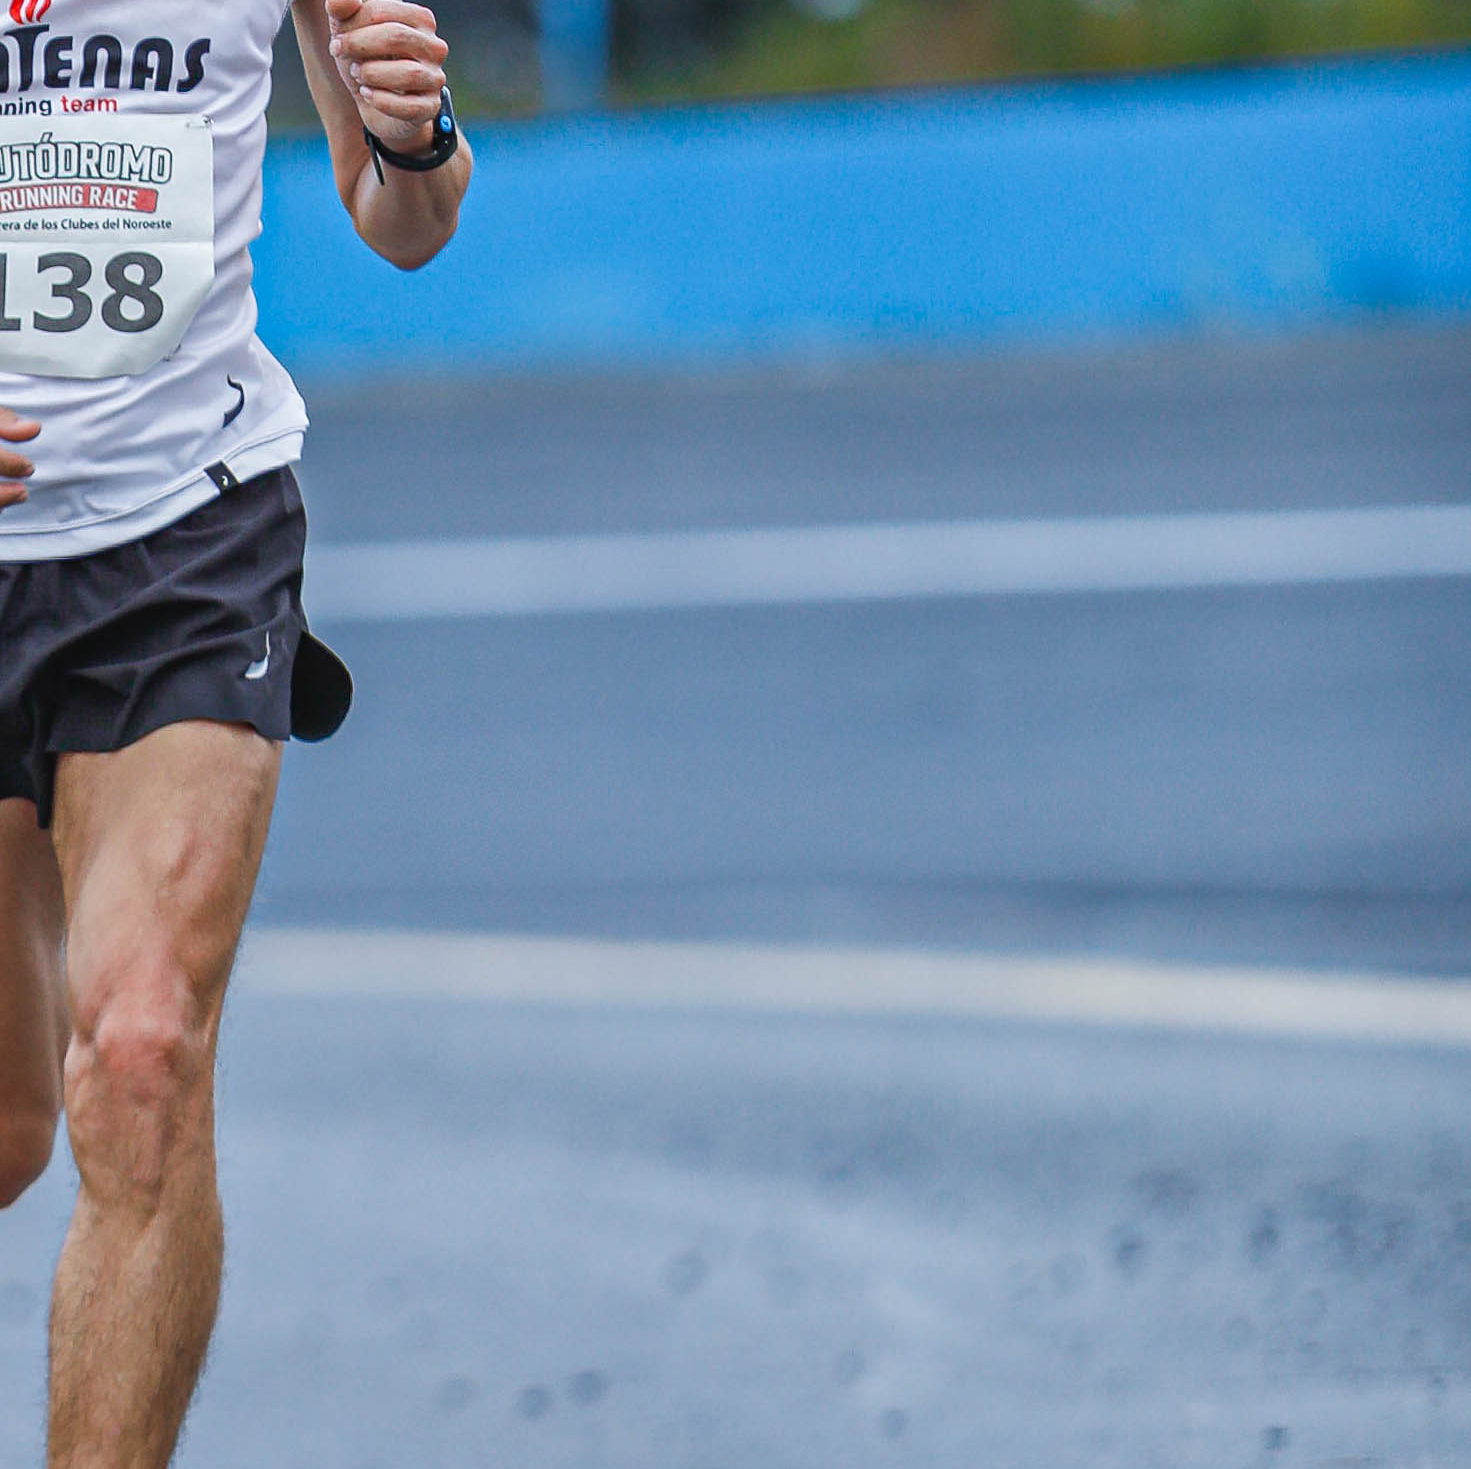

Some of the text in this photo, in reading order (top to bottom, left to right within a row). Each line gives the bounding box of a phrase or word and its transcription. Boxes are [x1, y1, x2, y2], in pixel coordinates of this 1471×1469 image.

[61, 95, 118, 112] team
[0, 185, 139, 212] RUNNING RACE
[23, 218, 38, 230] de
[41, 218, 58, 230] los
[60, 218, 99, 230] Clubes
[102, 218, 120, 229] del
[122, 218, 172, 229] Noroeste
